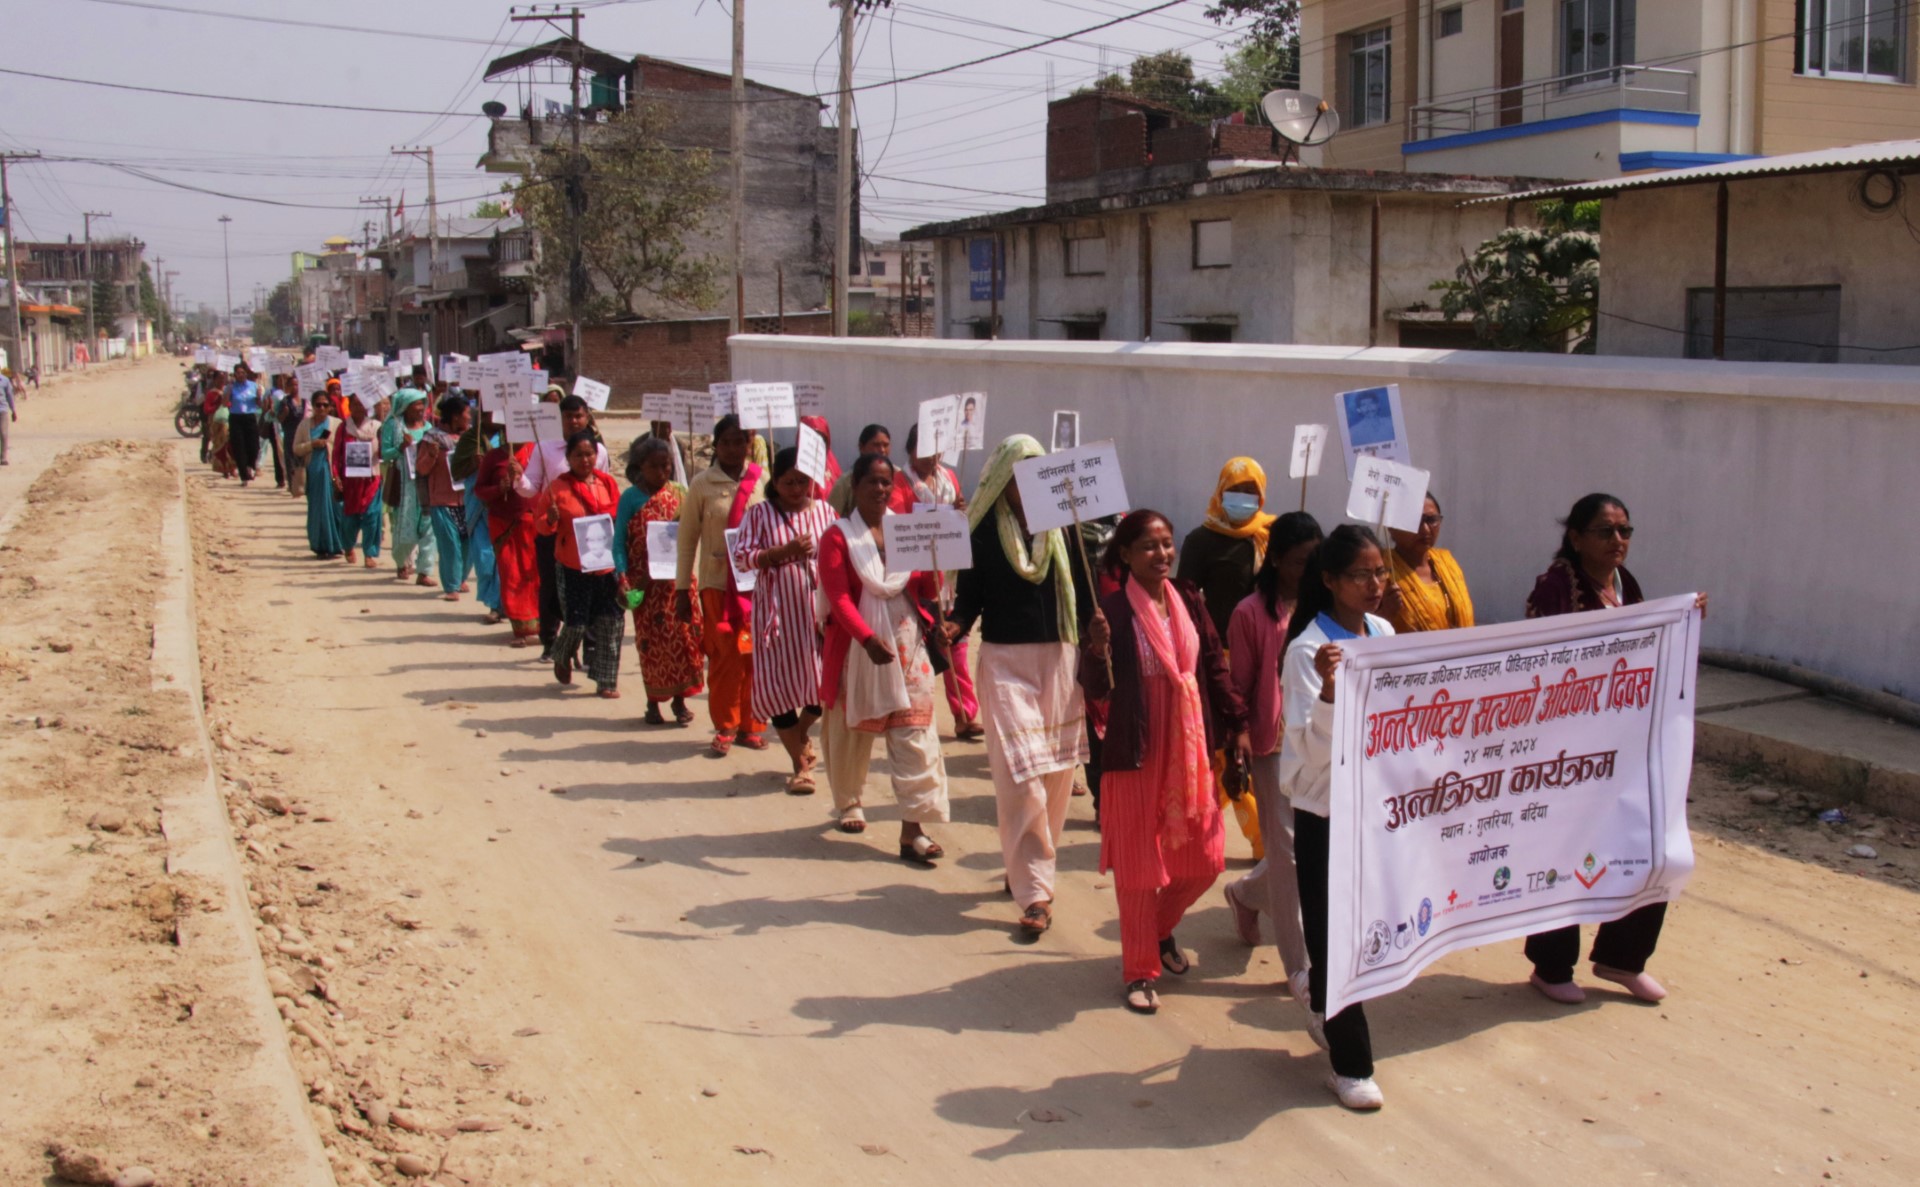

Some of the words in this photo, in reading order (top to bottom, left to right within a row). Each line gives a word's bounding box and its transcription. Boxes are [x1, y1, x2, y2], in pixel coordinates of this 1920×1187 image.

[1081, 456, 1102, 470] आम
[1078, 475, 1097, 489] दिन
[1403, 671, 1428, 688] मानव
[1429, 664, 1462, 685] अधिकार
[1551, 646, 1573, 665] मर्यादा
[1581, 640, 1606, 661] सत्यको
[1471, 674, 1542, 738] सत्यको
[1537, 667, 1607, 723] अधिकार
[1605, 657, 1654, 713] दिवस
[1463, 749, 1479, 766] २४
[1510, 737, 1538, 757] २०२४
[1509, 749, 1618, 796] कार्यक्रम
[1441, 822, 1465, 841] स्थान
[1468, 844, 1510, 865] आयोजक
